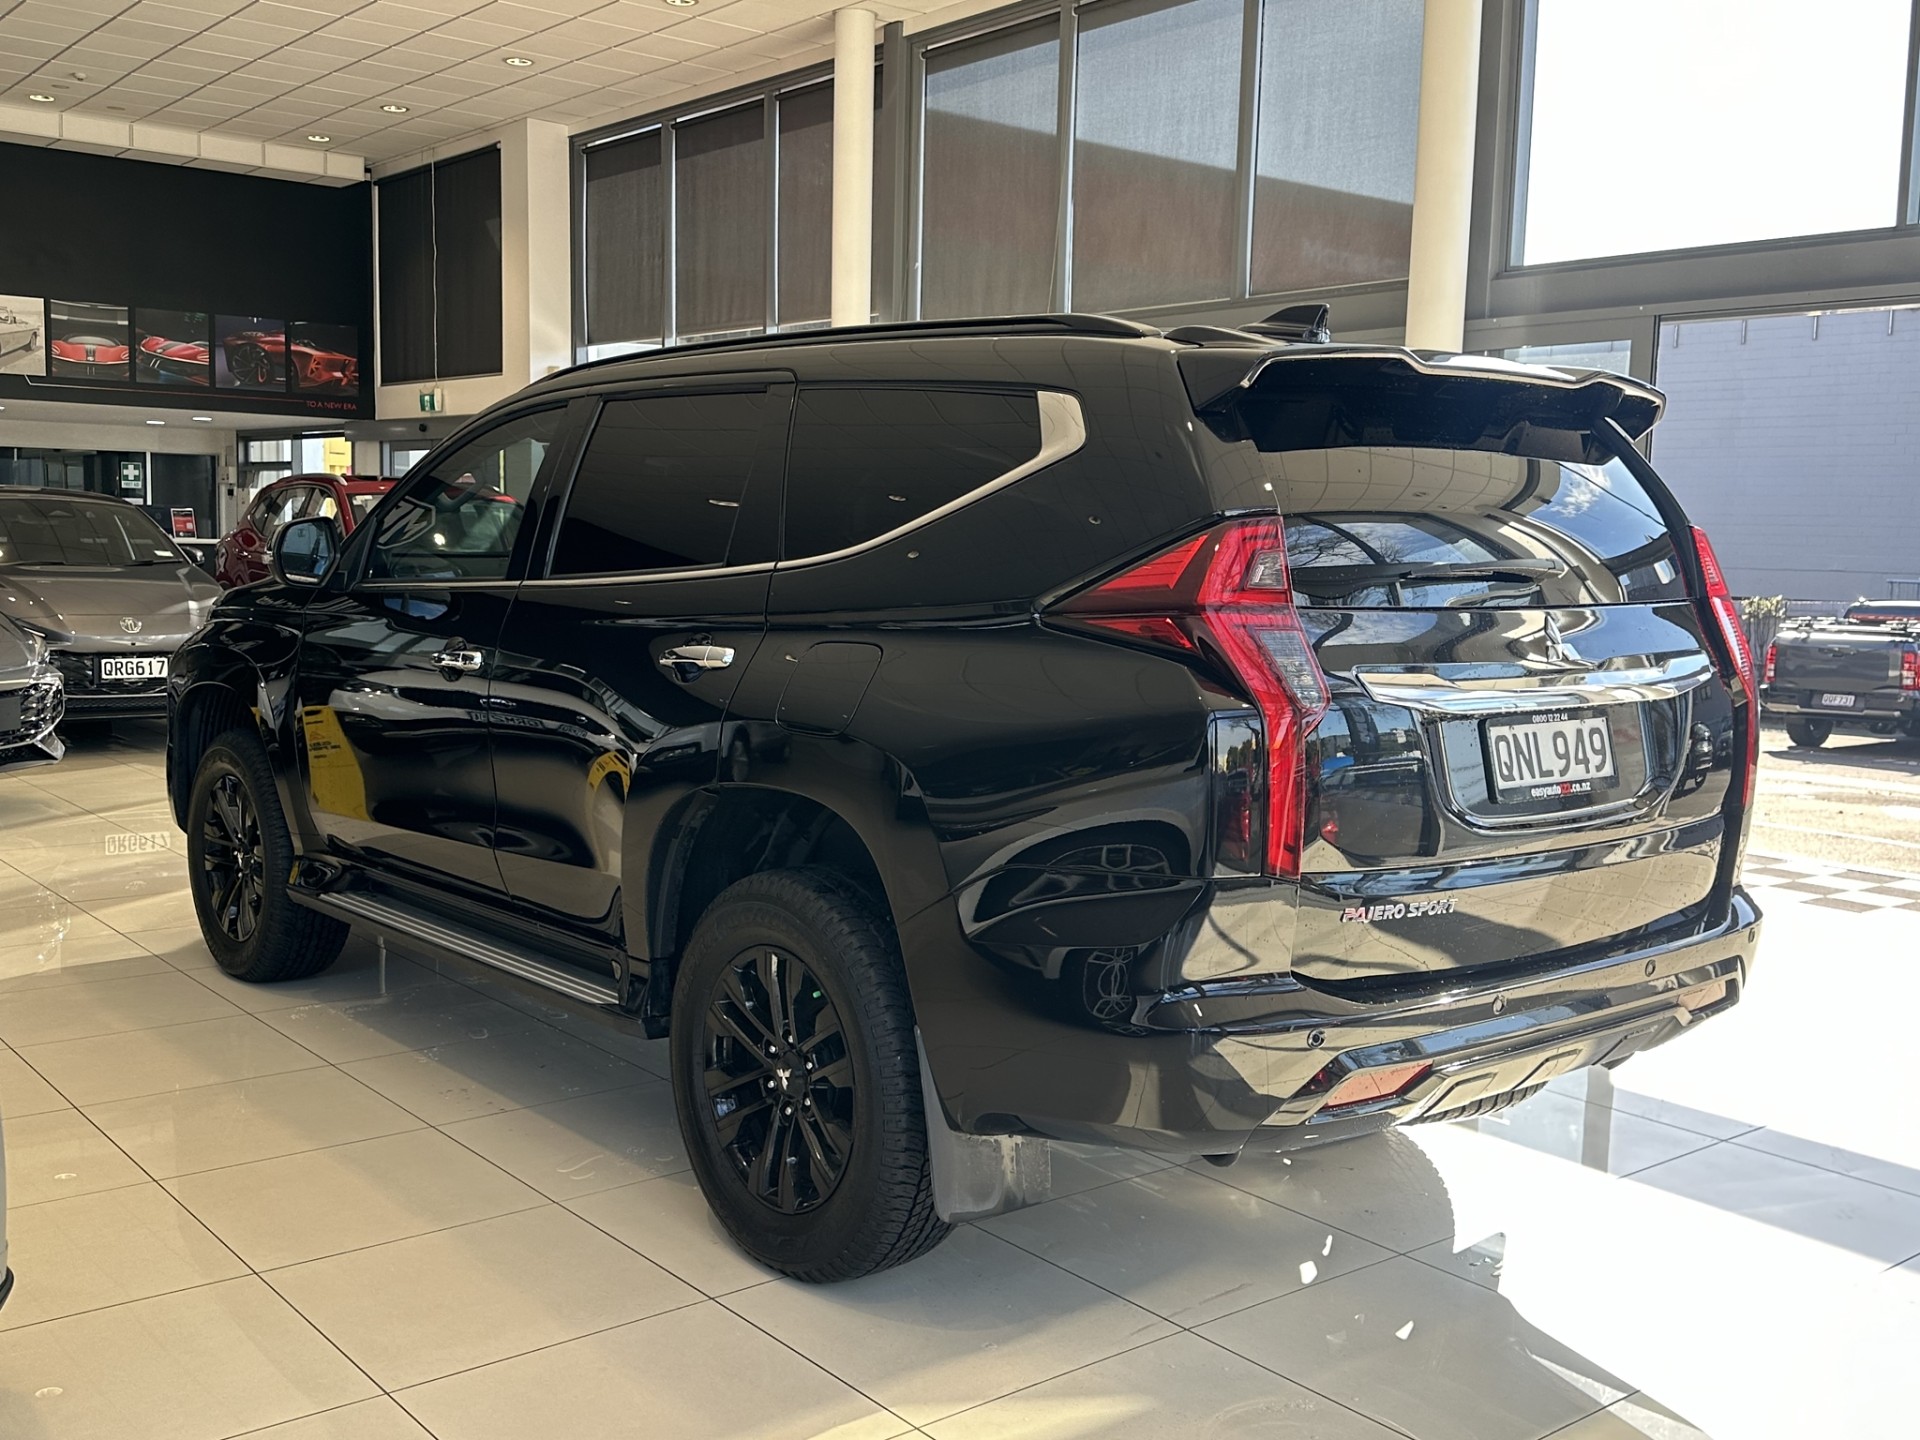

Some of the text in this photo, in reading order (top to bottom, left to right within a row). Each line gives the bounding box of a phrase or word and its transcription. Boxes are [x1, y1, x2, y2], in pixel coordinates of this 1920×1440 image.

[306, 400, 317, 409] TO
[324, 401, 343, 410] NEW
[343, 402, 358, 411] ERA
[103, 660, 166, 676] QRG617
[1495, 727, 1607, 782] QNL949
[1530, 781, 1592, 798] easyauto123.co.nz
[1342, 898, 1459, 924] PAJERO SPORT
